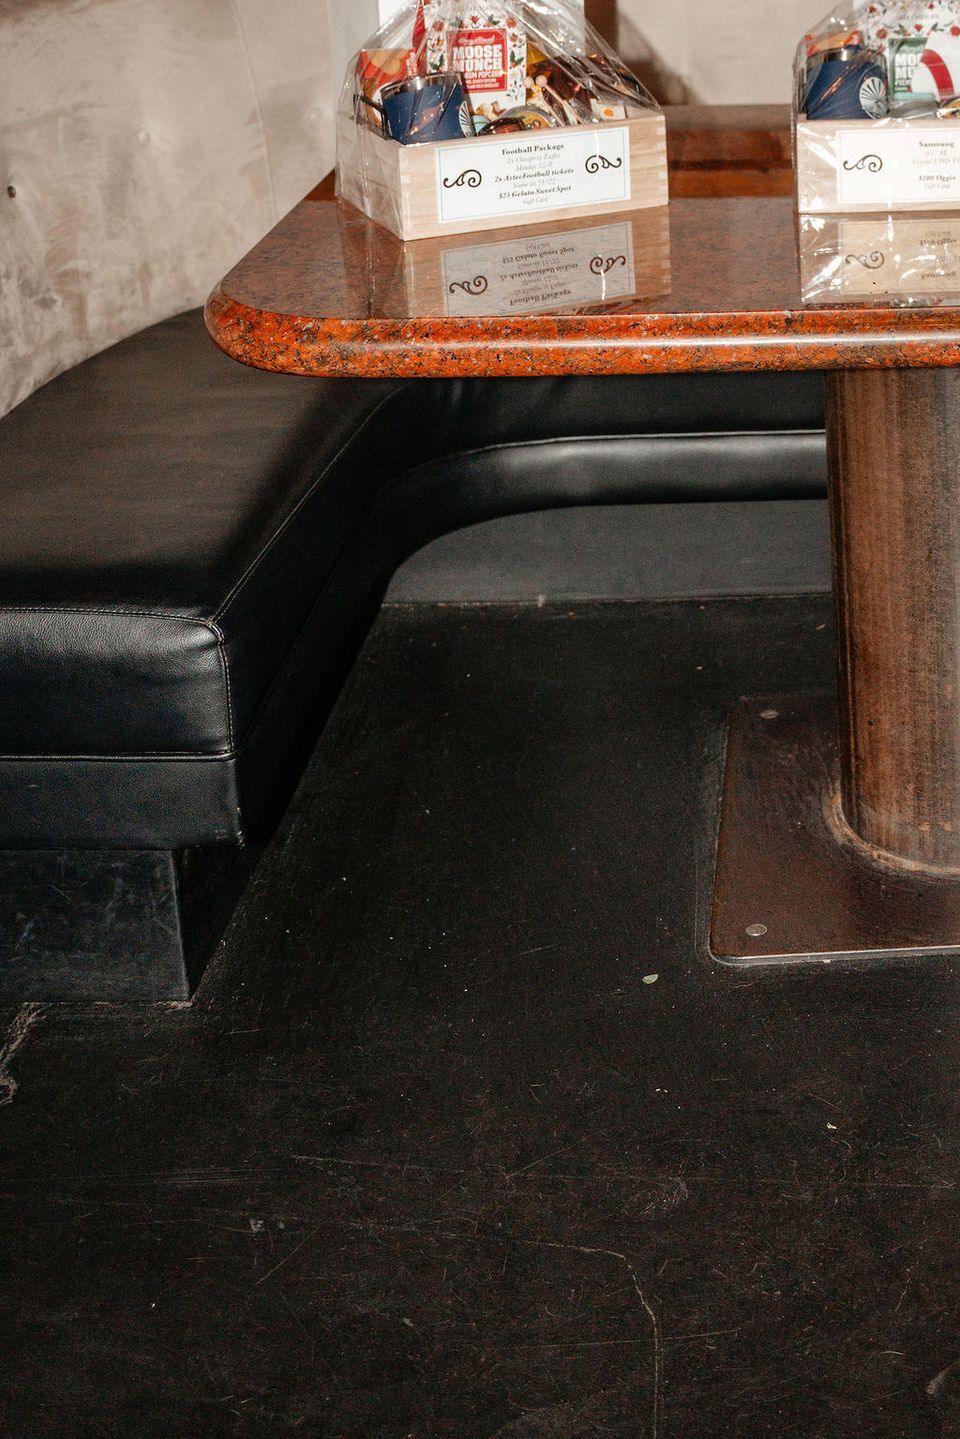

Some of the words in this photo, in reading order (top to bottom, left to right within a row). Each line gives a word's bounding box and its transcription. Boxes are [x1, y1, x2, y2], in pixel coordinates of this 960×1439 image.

[452, 44, 503, 60] MOOSE
[452, 57, 503, 72] MUNCH
[501, 145, 533, 156] Football
[534, 143, 565, 152] Package
[918, 141, 955, 149] Samsung
[551, 167, 574, 176] tickets
[511, 189, 535, 198] Gelato
[535, 186, 555, 195] Sweet
[555, 184, 572, 193] Spot
